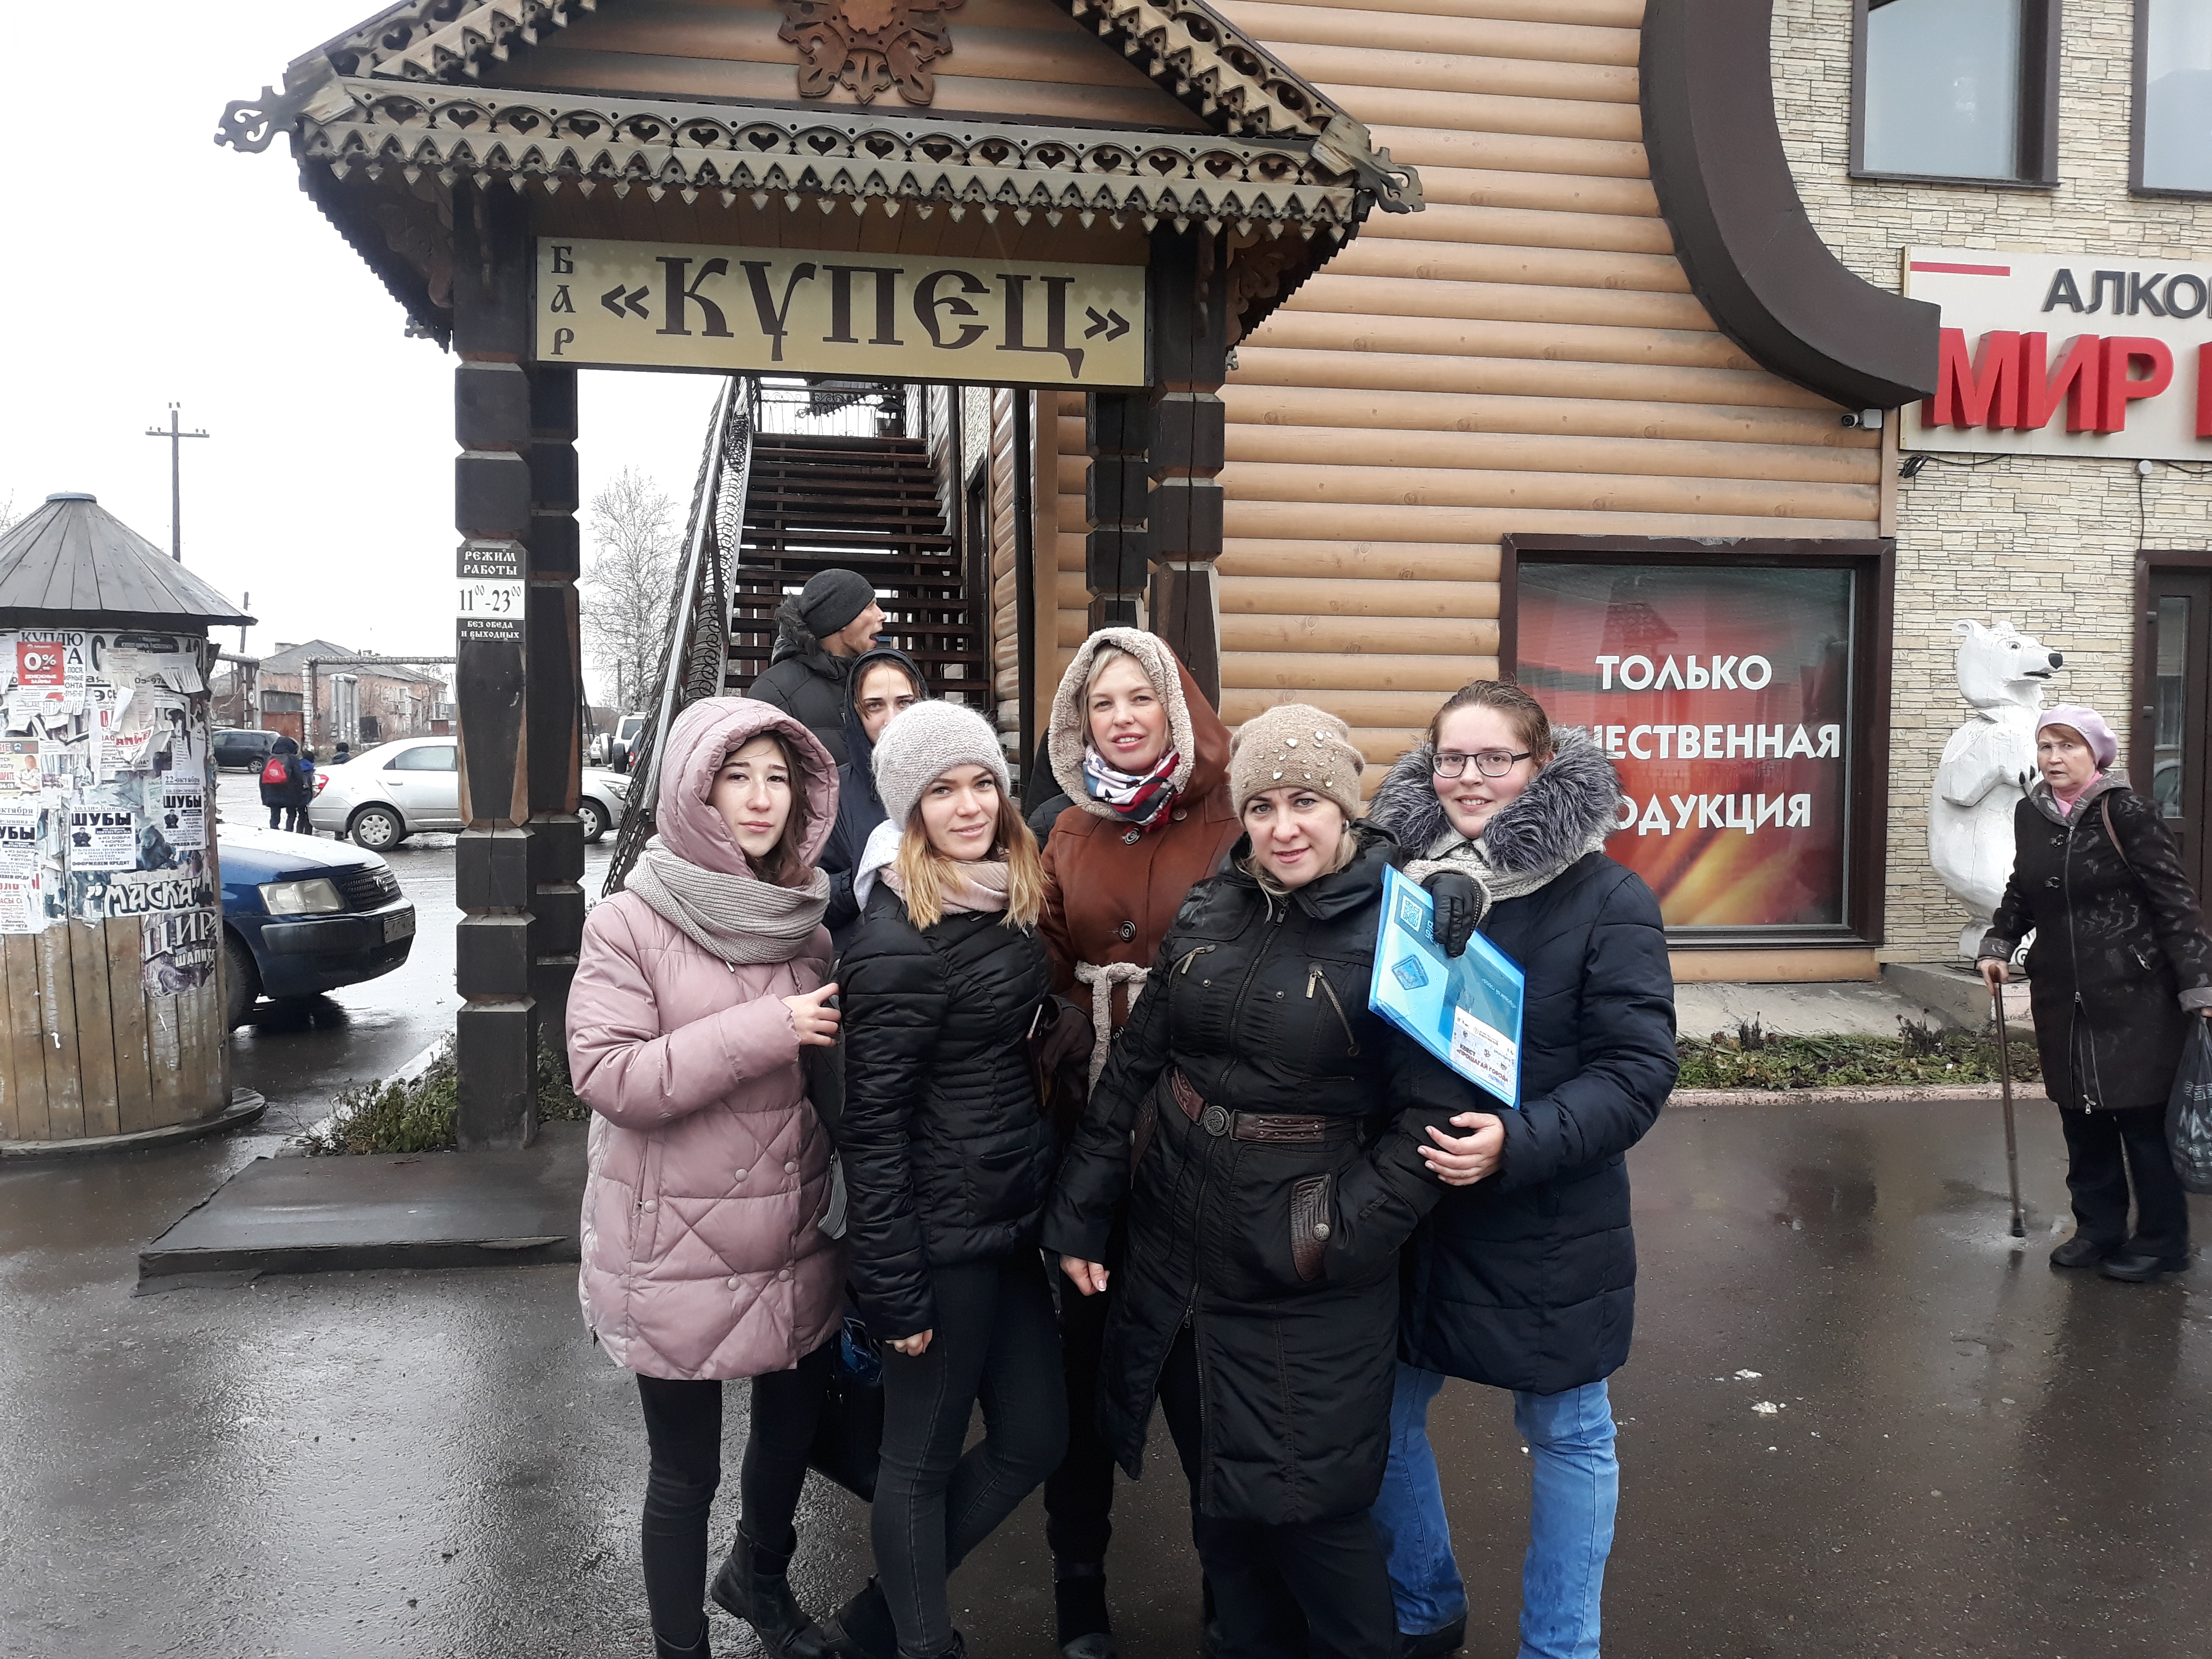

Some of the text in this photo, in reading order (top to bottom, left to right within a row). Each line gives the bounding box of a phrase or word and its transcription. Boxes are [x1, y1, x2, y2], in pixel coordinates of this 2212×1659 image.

[550, 245, 576, 356] БАР
[2042, 268, 2212, 319] АЛКО
[1922, 327, 2174, 434] МИР
[464, 551, 517, 562] РЕЖИМ
[462, 564, 518, 575] РАБОТЫ
[467, 621, 514, 630] БЕЗ ОБЕДА
[21, 632, 84, 646] КУПЛЮ
[469, 631, 520, 639] ВЫХОДНЫХ
[1595, 654, 1773, 691] ТОЛЬКО
[163, 795, 202, 808] ШУБЫ
[0, 806, 33, 814] ктября
[1616, 792, 1811, 836] ОДУКЦИЯ
[71, 812, 131, 826] ШУБЫ
[175, 948, 216, 968] ШАПИТ
